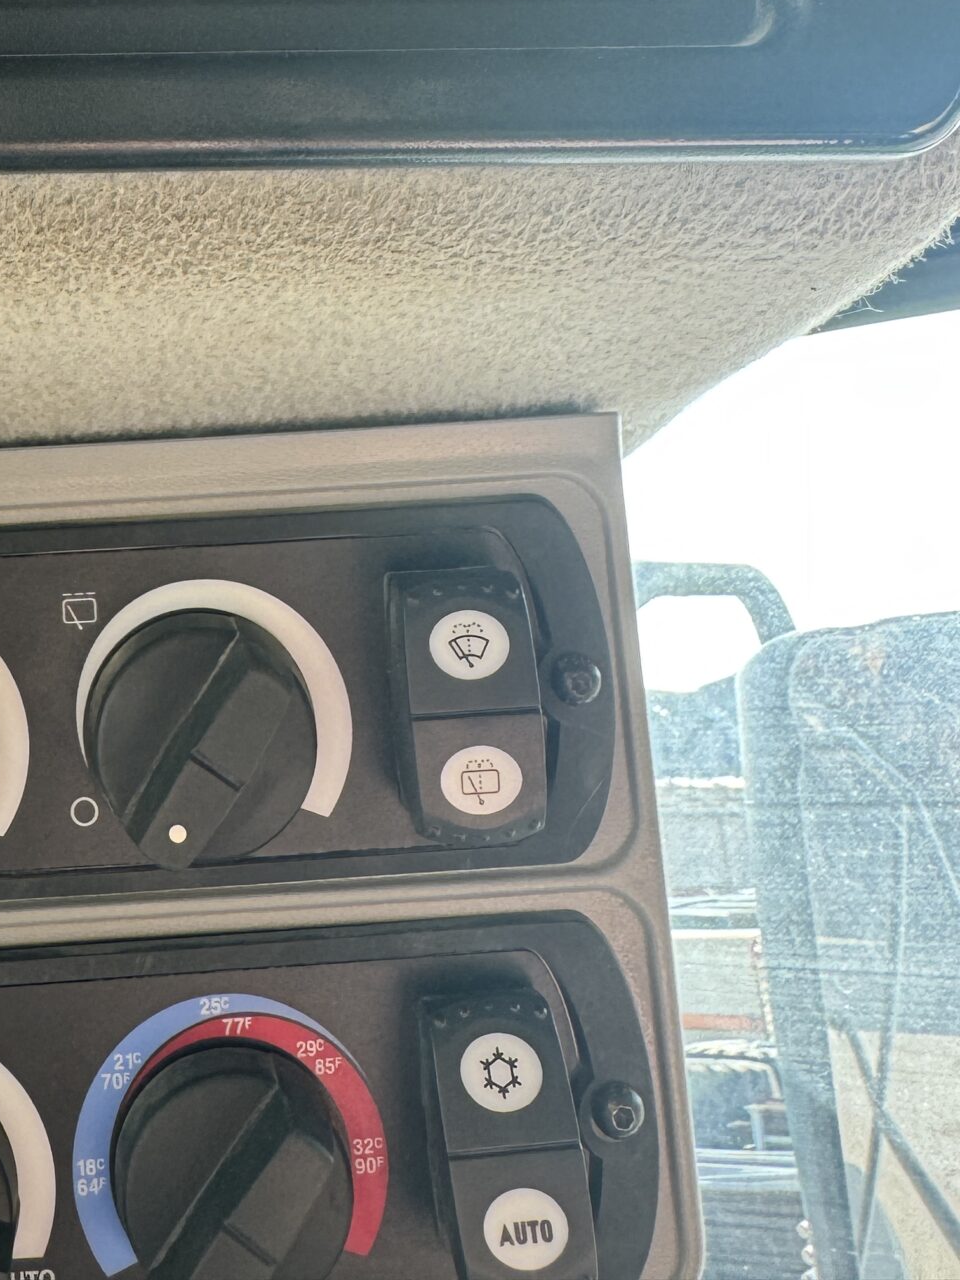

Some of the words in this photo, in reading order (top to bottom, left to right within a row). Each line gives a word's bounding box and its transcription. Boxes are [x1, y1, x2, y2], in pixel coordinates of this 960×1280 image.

[199, 996, 229, 1016] 25C
[222, 1016, 253, 1036] 77F
[296, 1039, 325, 1058] 29C
[113, 1052, 142, 1071] 21C
[315, 1056, 343, 1075] 85F
[101, 1072, 131, 1090] 70F
[353, 1138, 384, 1155] 32C
[76, 1158, 105, 1176] 18C
[354, 1157, 385, 1174] 90F
[76, 1178, 107, 1196] 64F
[500, 1219, 555, 1247] AUTO
